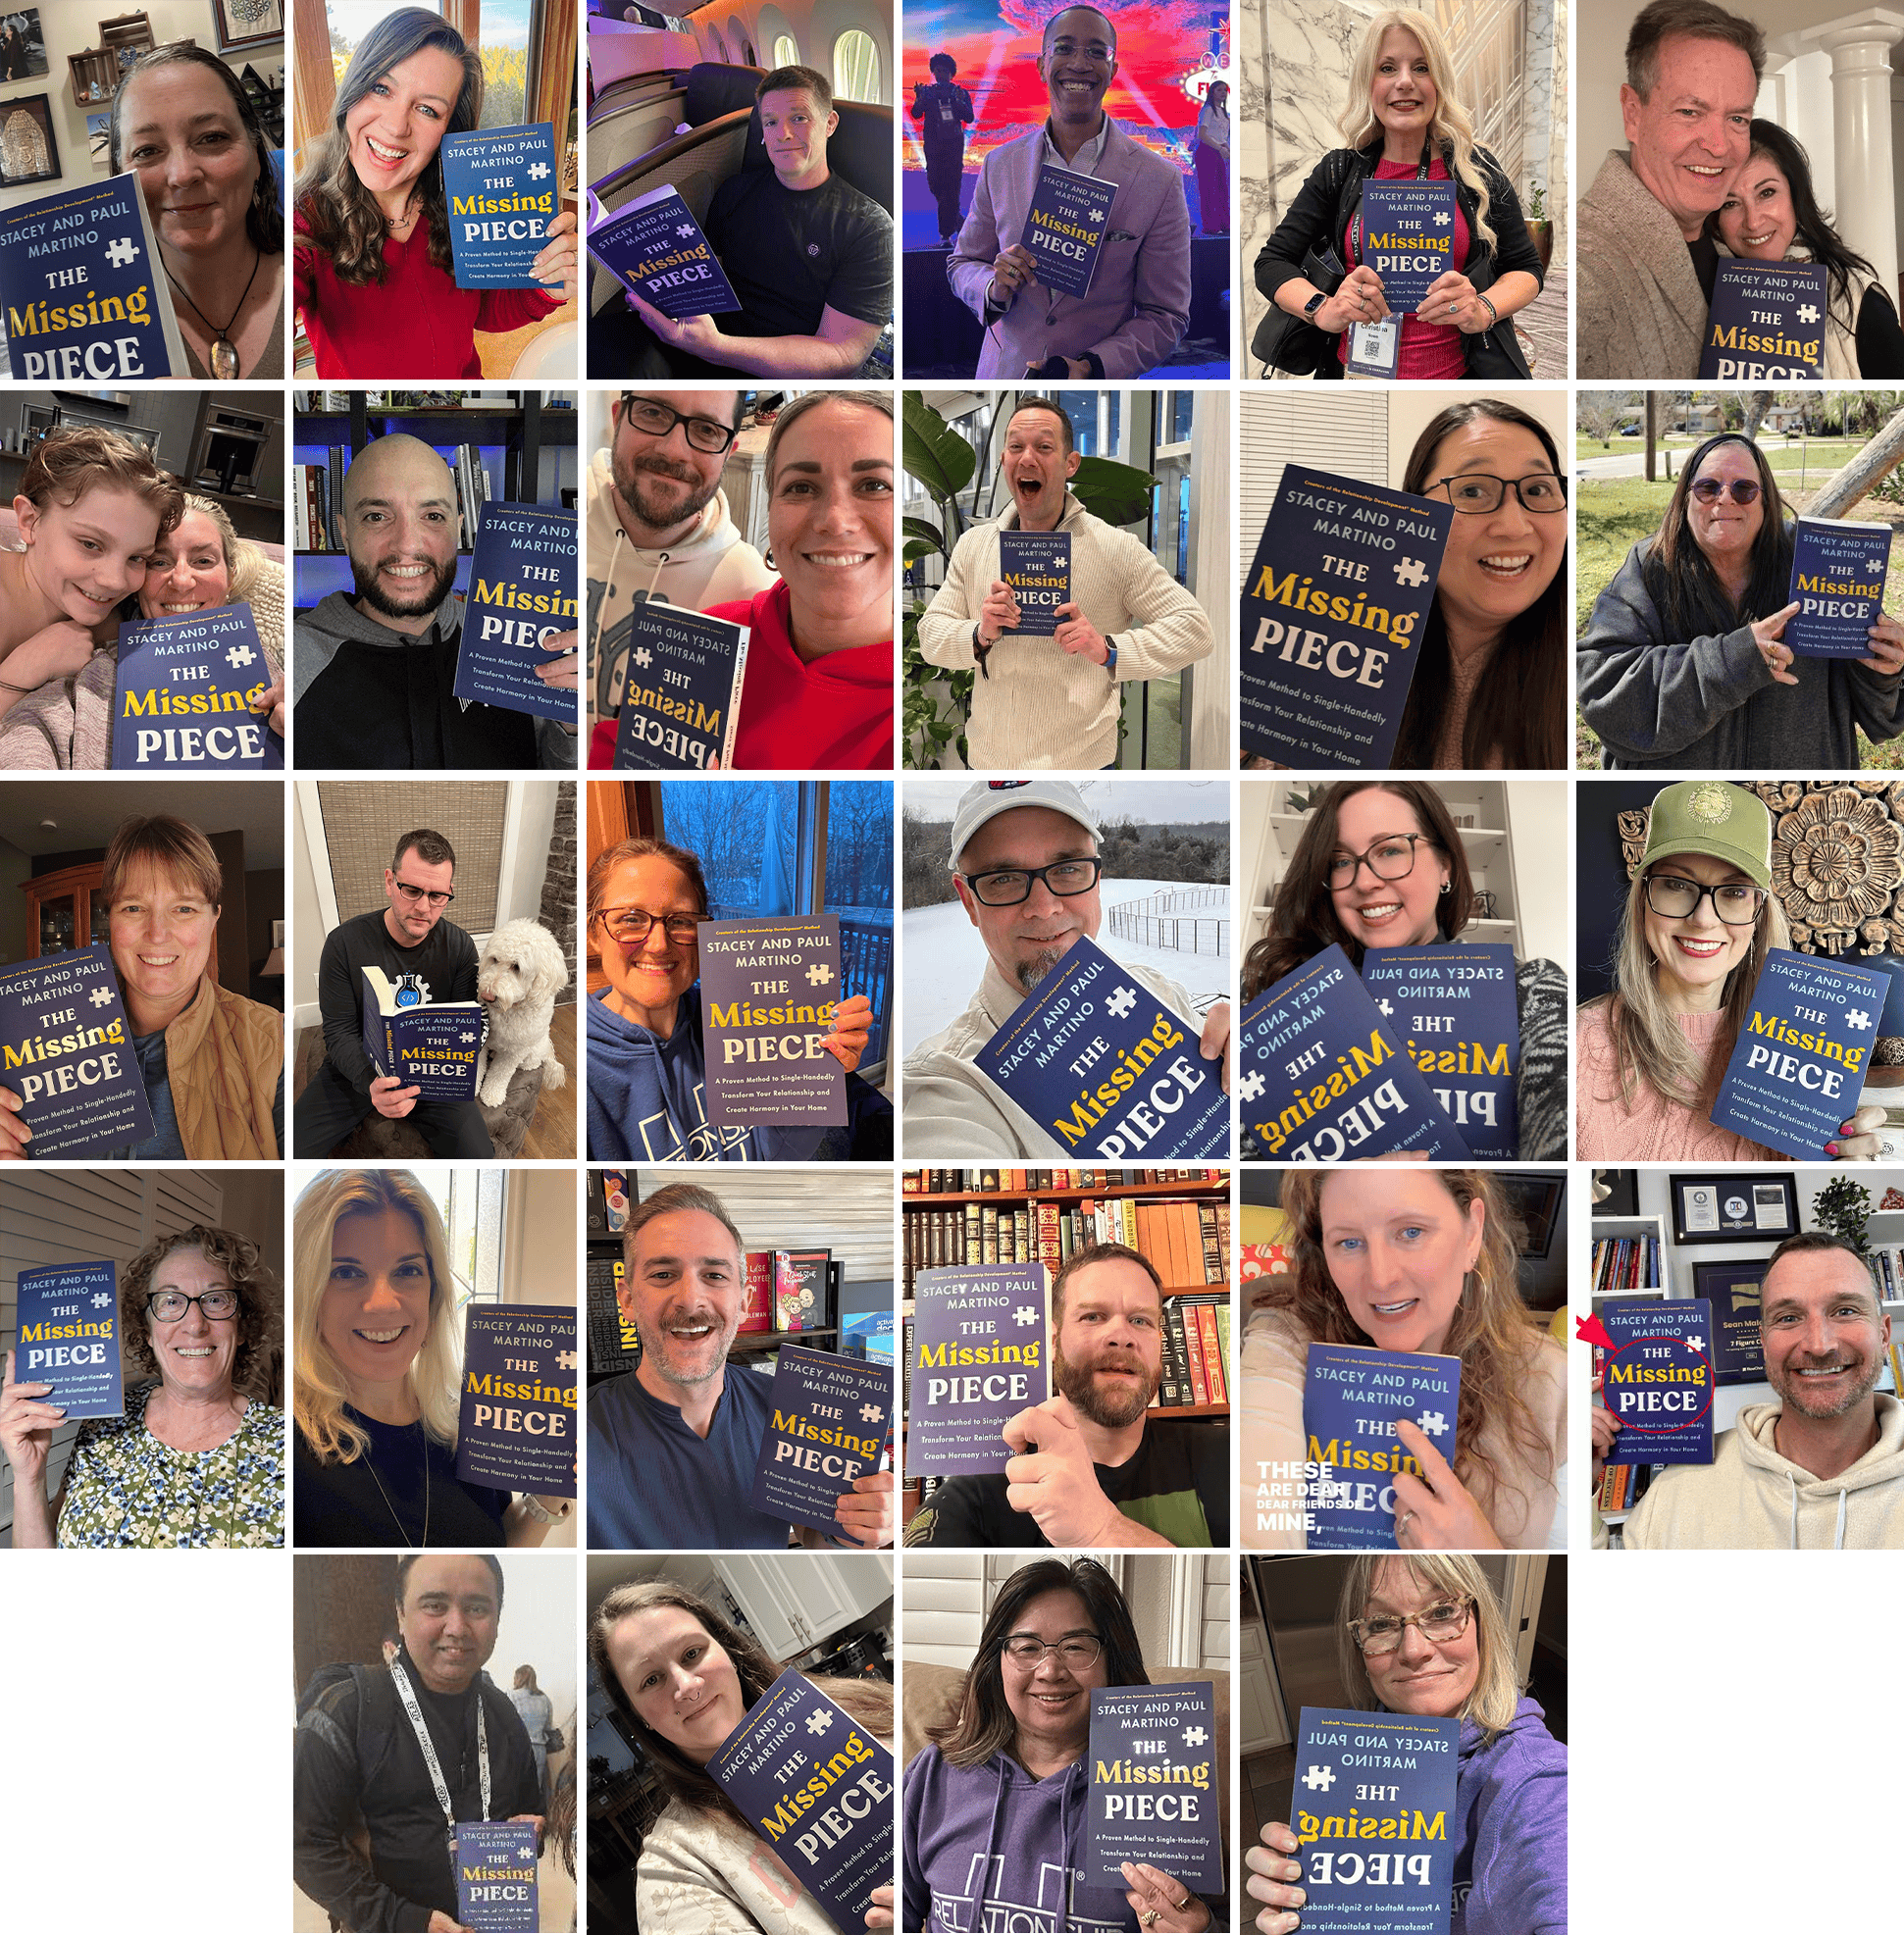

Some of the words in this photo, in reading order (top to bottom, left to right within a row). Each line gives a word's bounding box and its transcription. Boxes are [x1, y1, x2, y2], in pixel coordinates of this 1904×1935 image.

[447, 146, 486, 158] STACEY
[490, 143, 515, 154] AND
[519, 139, 548, 151] PAUL
[452, 191, 553, 216] Missing
[1057, 205, 1079, 220] THE
[463, 219, 545, 242] PIECE
[1030, 208, 1100, 248] Missing
[643, 239, 672, 255] THE
[1031, 229, 1087, 263] PIECE
[1368, 231, 1452, 255] Missing
[626, 243, 711, 278] Missing
[1376, 255, 1442, 274] PIECE
[45, 265, 88, 290] THE
[645, 263, 713, 292] PIECE
[1741, 288, 1795, 302] MARTINO
[5, 286, 153, 338] Missing
[20, 337, 145, 380] PIECE
[1710, 324, 1821, 368] Missing
[1286, 490, 1347, 516] STACEY
[1351, 508, 1389, 527] AND
[1395, 519, 1437, 541] PAUL
[510, 537, 578, 556] MARTINO
[521, 564, 560, 583] THE
[1004, 573, 1068, 591] Missing
[1828, 565, 1854, 576] THE
[1010, 590, 1062, 606] PIECE
[1796, 575, 1882, 602] Missing
[1252, 564, 1419, 651] Missing
[1802, 598, 1871, 620] PIECE
[1251, 615, 1389, 690] PIECE
[138, 725, 267, 762] PIECE
[22, 983, 83, 1006] MARTINO
[2, 1018, 126, 1070] Missing
[722, 1035, 825, 1063] PIECE
[1747, 1010, 1866, 1074] Missing
[401, 1046, 477, 1064] Missing
[20, 1052, 123, 1102] PIECE
[408, 1062, 467, 1077] PIECE
[746, 1075, 770, 1084] Method
[780, 1073, 836, 1083] Single-Handedly
[1052, 1013, 1186, 1148] Missing
[1746, 1044, 1844, 1100] PIECE
[1095, 1056, 1208, 1160] PIECE
[35, 1145, 58, 1155] Create
[59, 1135, 89, 1148] Harmony
[99, 1128, 115, 1137] Your
[116, 1123, 135, 1132] Home
[51, 1304, 79, 1317] THE
[947, 1296, 1009, 1309] MARTINO
[20, 1318, 114, 1343] Missing
[1611, 1316, 1647, 1326] STACEY
[1651, 1315, 1674, 1324] AND
[1677, 1314, 1704, 1323] PAUL
[28, 1344, 106, 1369] PIECE
[916, 1338, 1041, 1370] Missing
[1735, 1340, 1755, 1349] Figure
[1610, 1361, 1707, 1388] Missing
[465, 1372, 578, 1412] Missing
[802, 1379, 859, 1400] MARTINO
[926, 1374, 1029, 1403] PIECE
[1342, 1388, 1415, 1407] MARTINO
[1620, 1391, 1698, 1411] PIECE
[474, 1403, 566, 1439] PIECE
[1355, 1417, 1397, 1438] THE
[770, 1409, 881, 1463] Missing
[470, 1464, 489, 1473] Create
[490, 1469, 518, 1480] Harmony
[774, 1440, 862, 1486] PIECE
[1603, 1478, 1613, 1507] SUCCESS
[747, 1721, 796, 1775] MARTINO
[759, 1731, 876, 1842] Missing
[1095, 1757, 1210, 1791] Missing
[793, 1769, 894, 1864] PIECE
[1105, 1794, 1200, 1822] PIECE
[487, 1855, 509, 1863] THE
[1148, 1851, 1189, 1861] Relationship
[463, 1864, 535, 1884] Missing
[470, 1885, 529, 1902] PIECE
